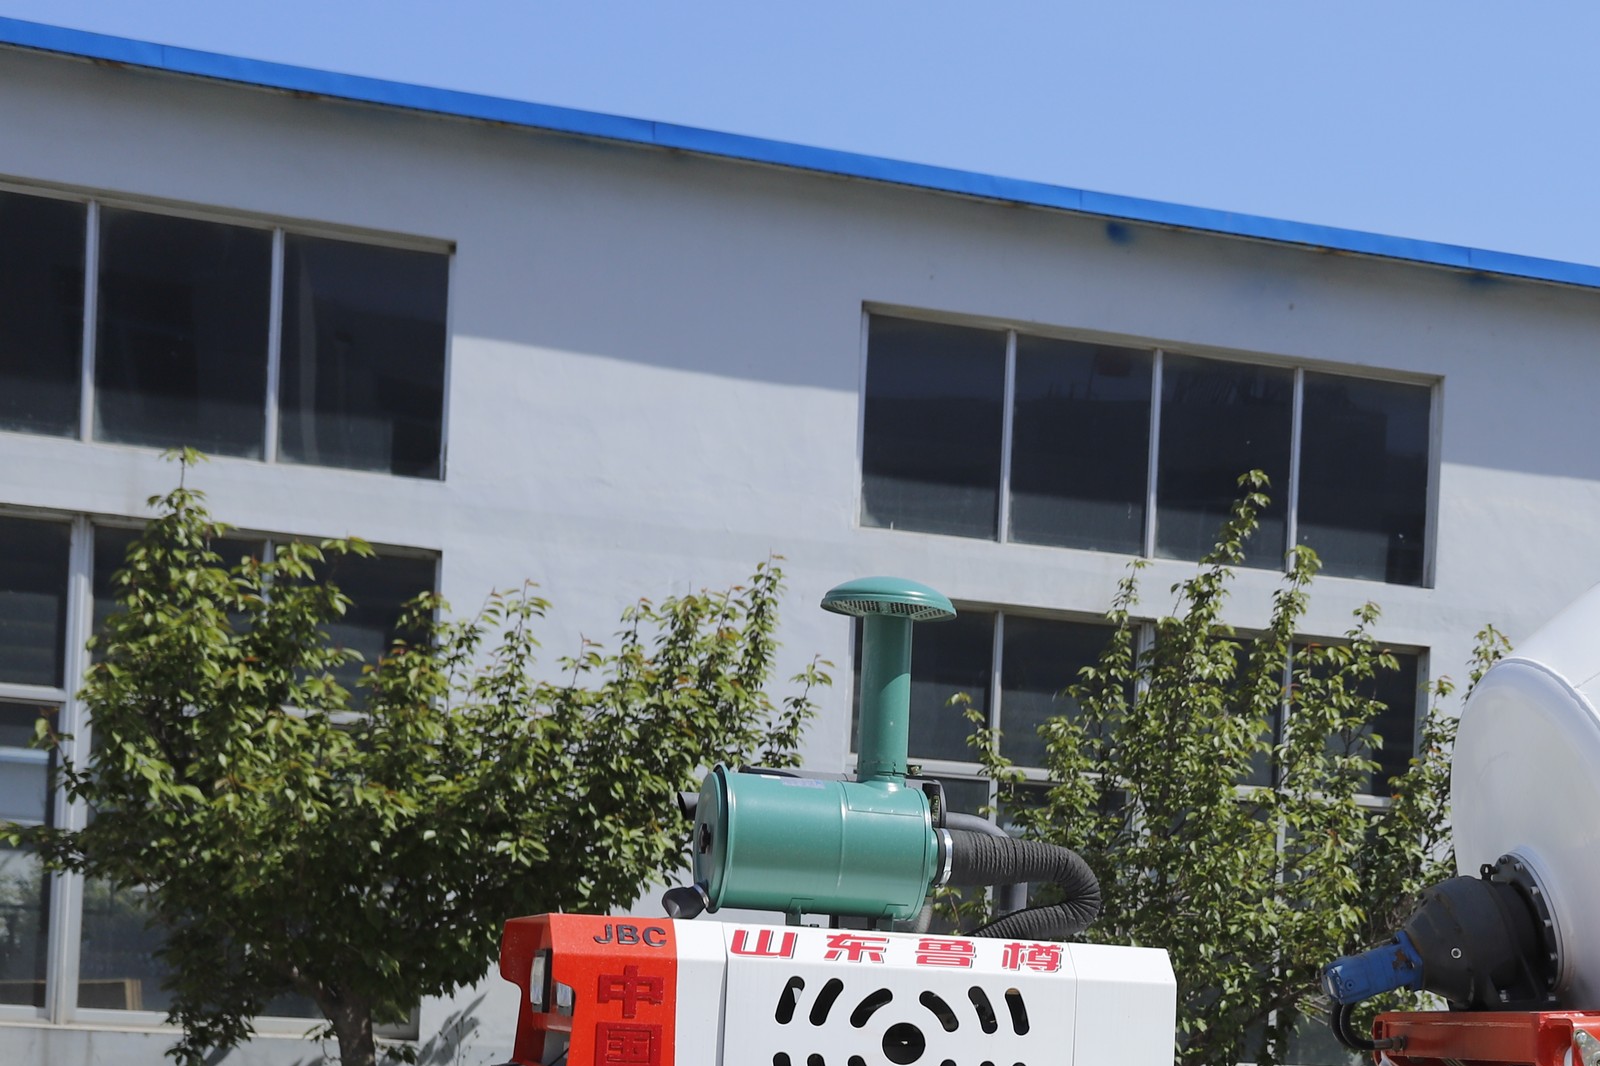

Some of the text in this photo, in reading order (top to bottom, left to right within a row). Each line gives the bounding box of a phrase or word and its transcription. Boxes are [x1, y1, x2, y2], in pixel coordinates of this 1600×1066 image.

[593, 923, 667, 947] JBC
[730, 928, 1063, 973] 山东鲁樽
